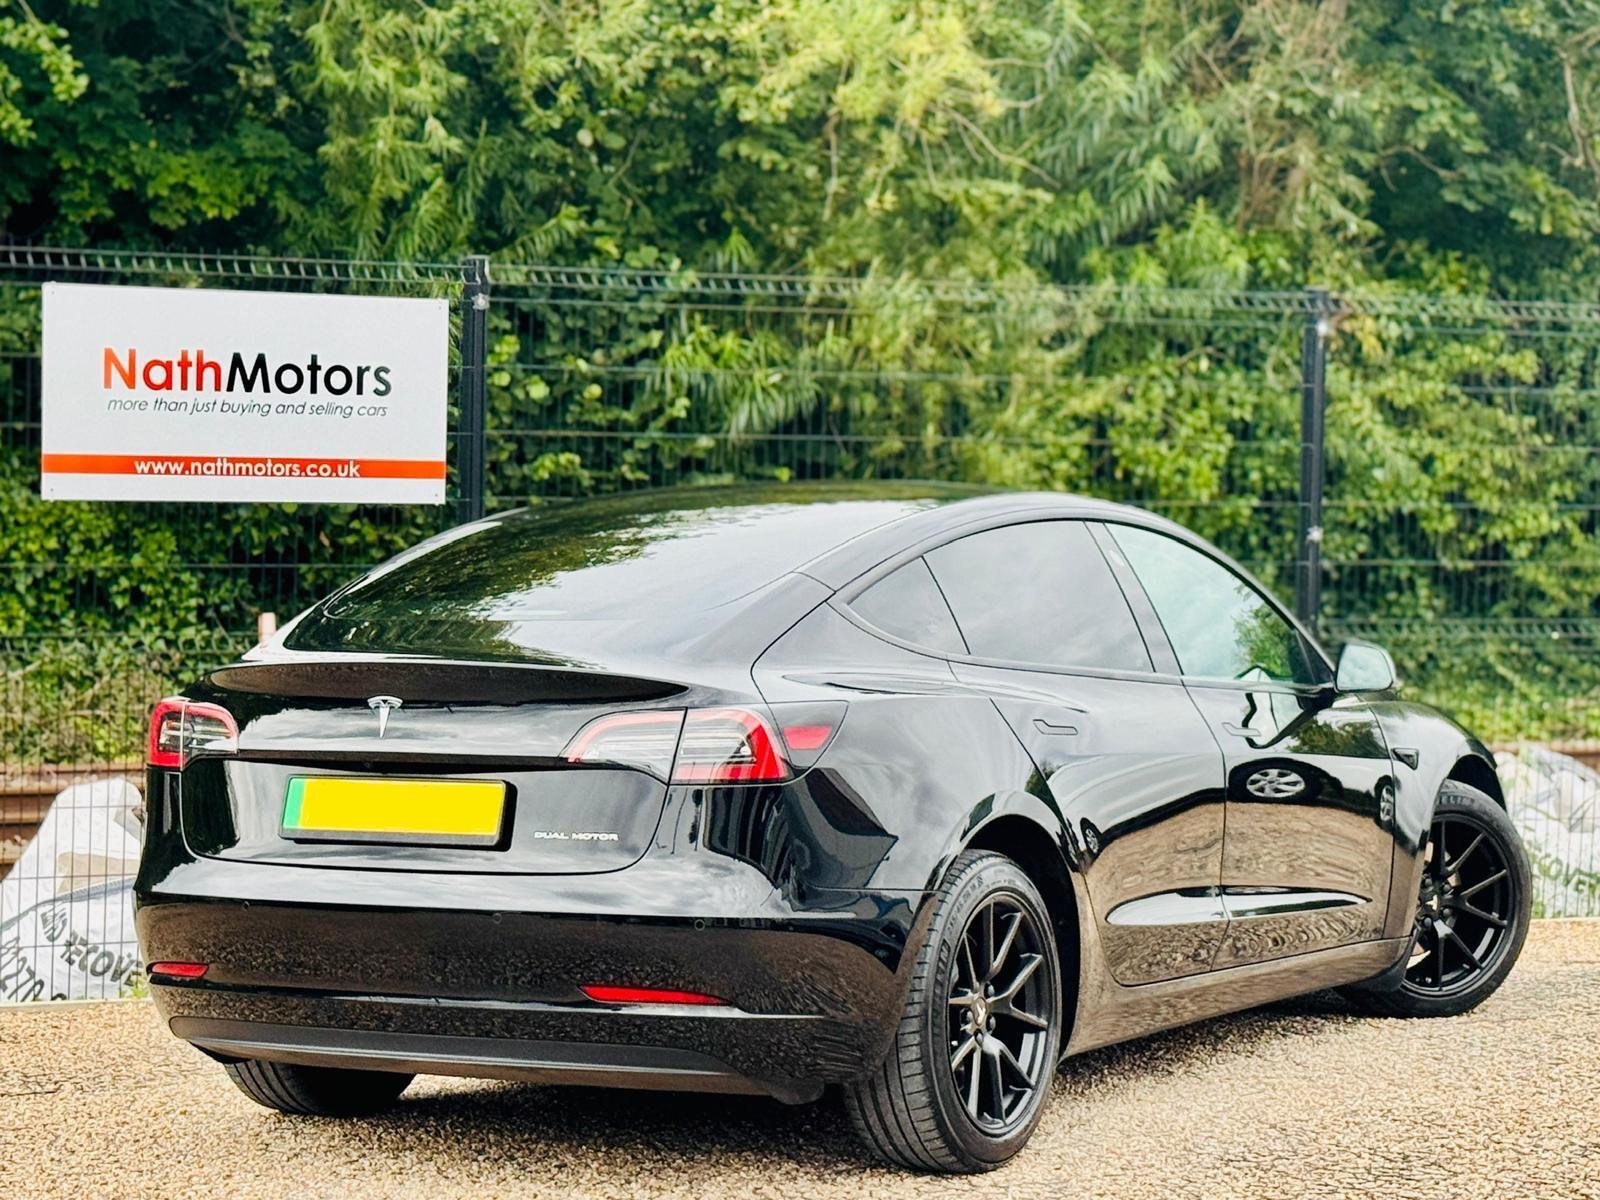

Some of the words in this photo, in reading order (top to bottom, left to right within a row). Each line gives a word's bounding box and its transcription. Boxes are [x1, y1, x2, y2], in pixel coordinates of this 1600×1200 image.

[103, 347, 392, 397] NathMotors
[107, 398, 149, 412] more
[153, 397, 188, 412] than
[189, 398, 217, 416] just
[220, 400, 271, 417] buying
[275, 401, 307, 415] and
[308, 402, 353, 419] selling
[357, 405, 388, 417] cars
[134, 457, 361, 478] www.nathmotors.co.uk
[534, 831, 569, 840] DUAL
[571, 832, 619, 841] MOTOR
